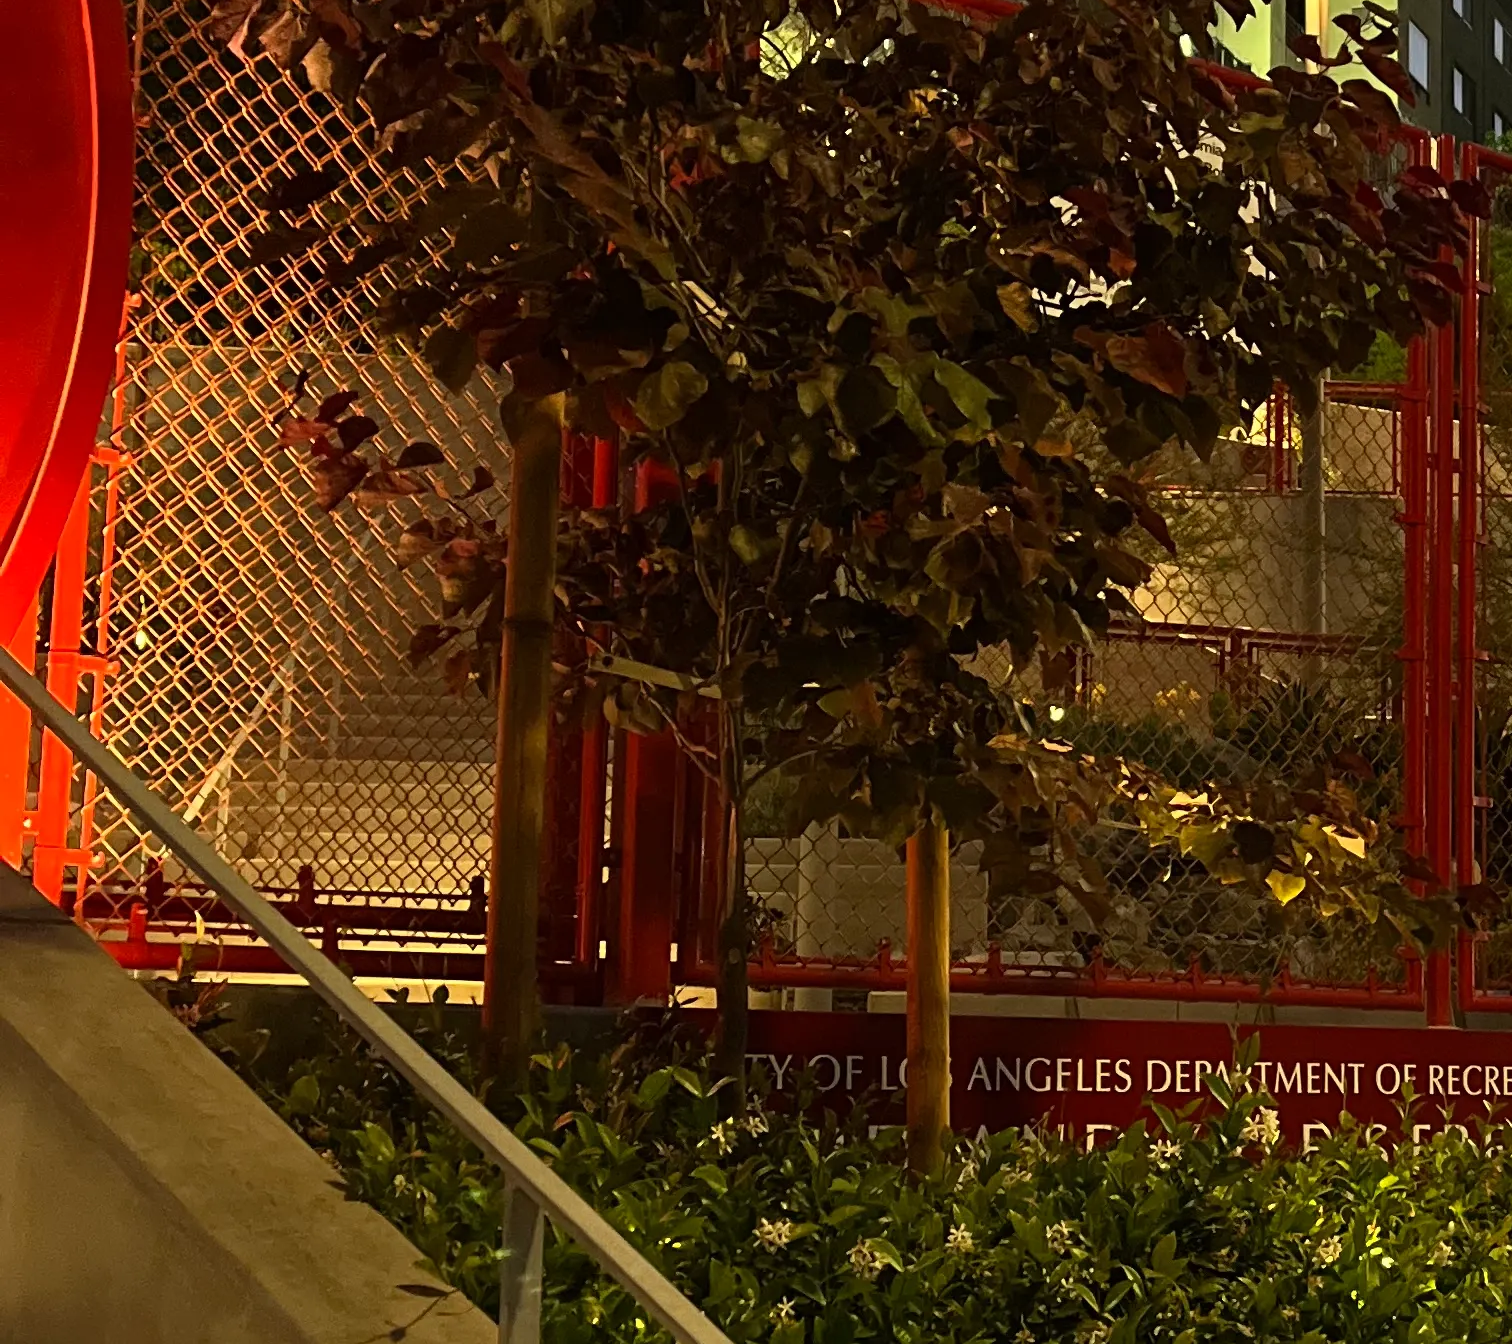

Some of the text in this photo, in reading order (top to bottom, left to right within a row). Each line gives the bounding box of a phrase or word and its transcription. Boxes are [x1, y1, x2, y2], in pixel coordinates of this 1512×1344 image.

[808, 1054, 864, 1092] OF
[967, 1056, 1133, 1093] ANGELES
[1375, 1062, 1417, 1095] OF
